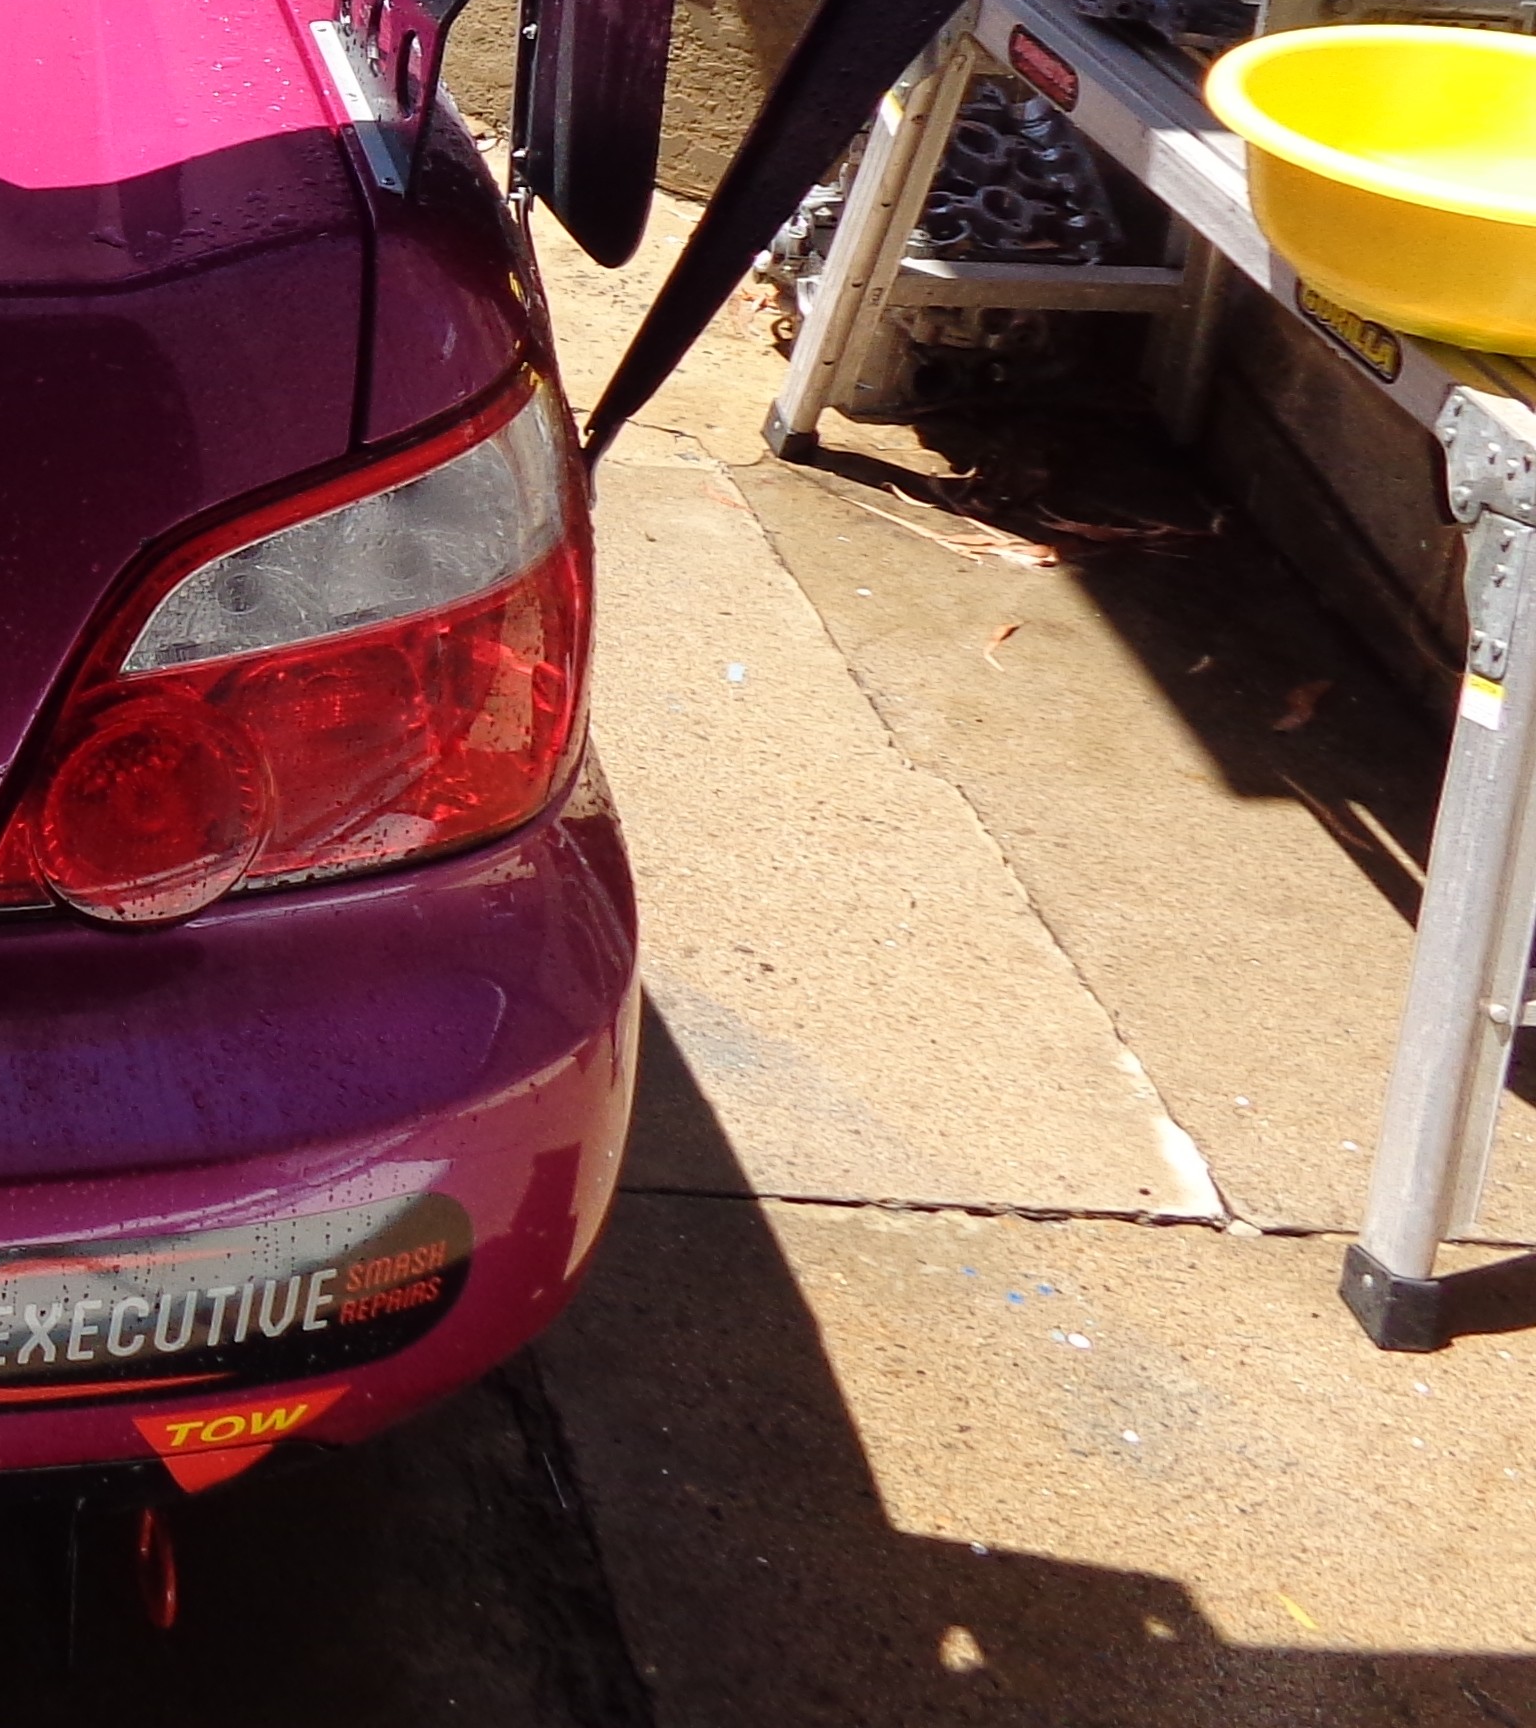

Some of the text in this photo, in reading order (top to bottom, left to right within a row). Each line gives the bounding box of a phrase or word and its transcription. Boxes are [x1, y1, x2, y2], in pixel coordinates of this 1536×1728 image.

[344, 1241, 448, 1293] SMASH
[339, 1276, 442, 1325] REPAIRS
[165, 1404, 309, 1447] TOW
